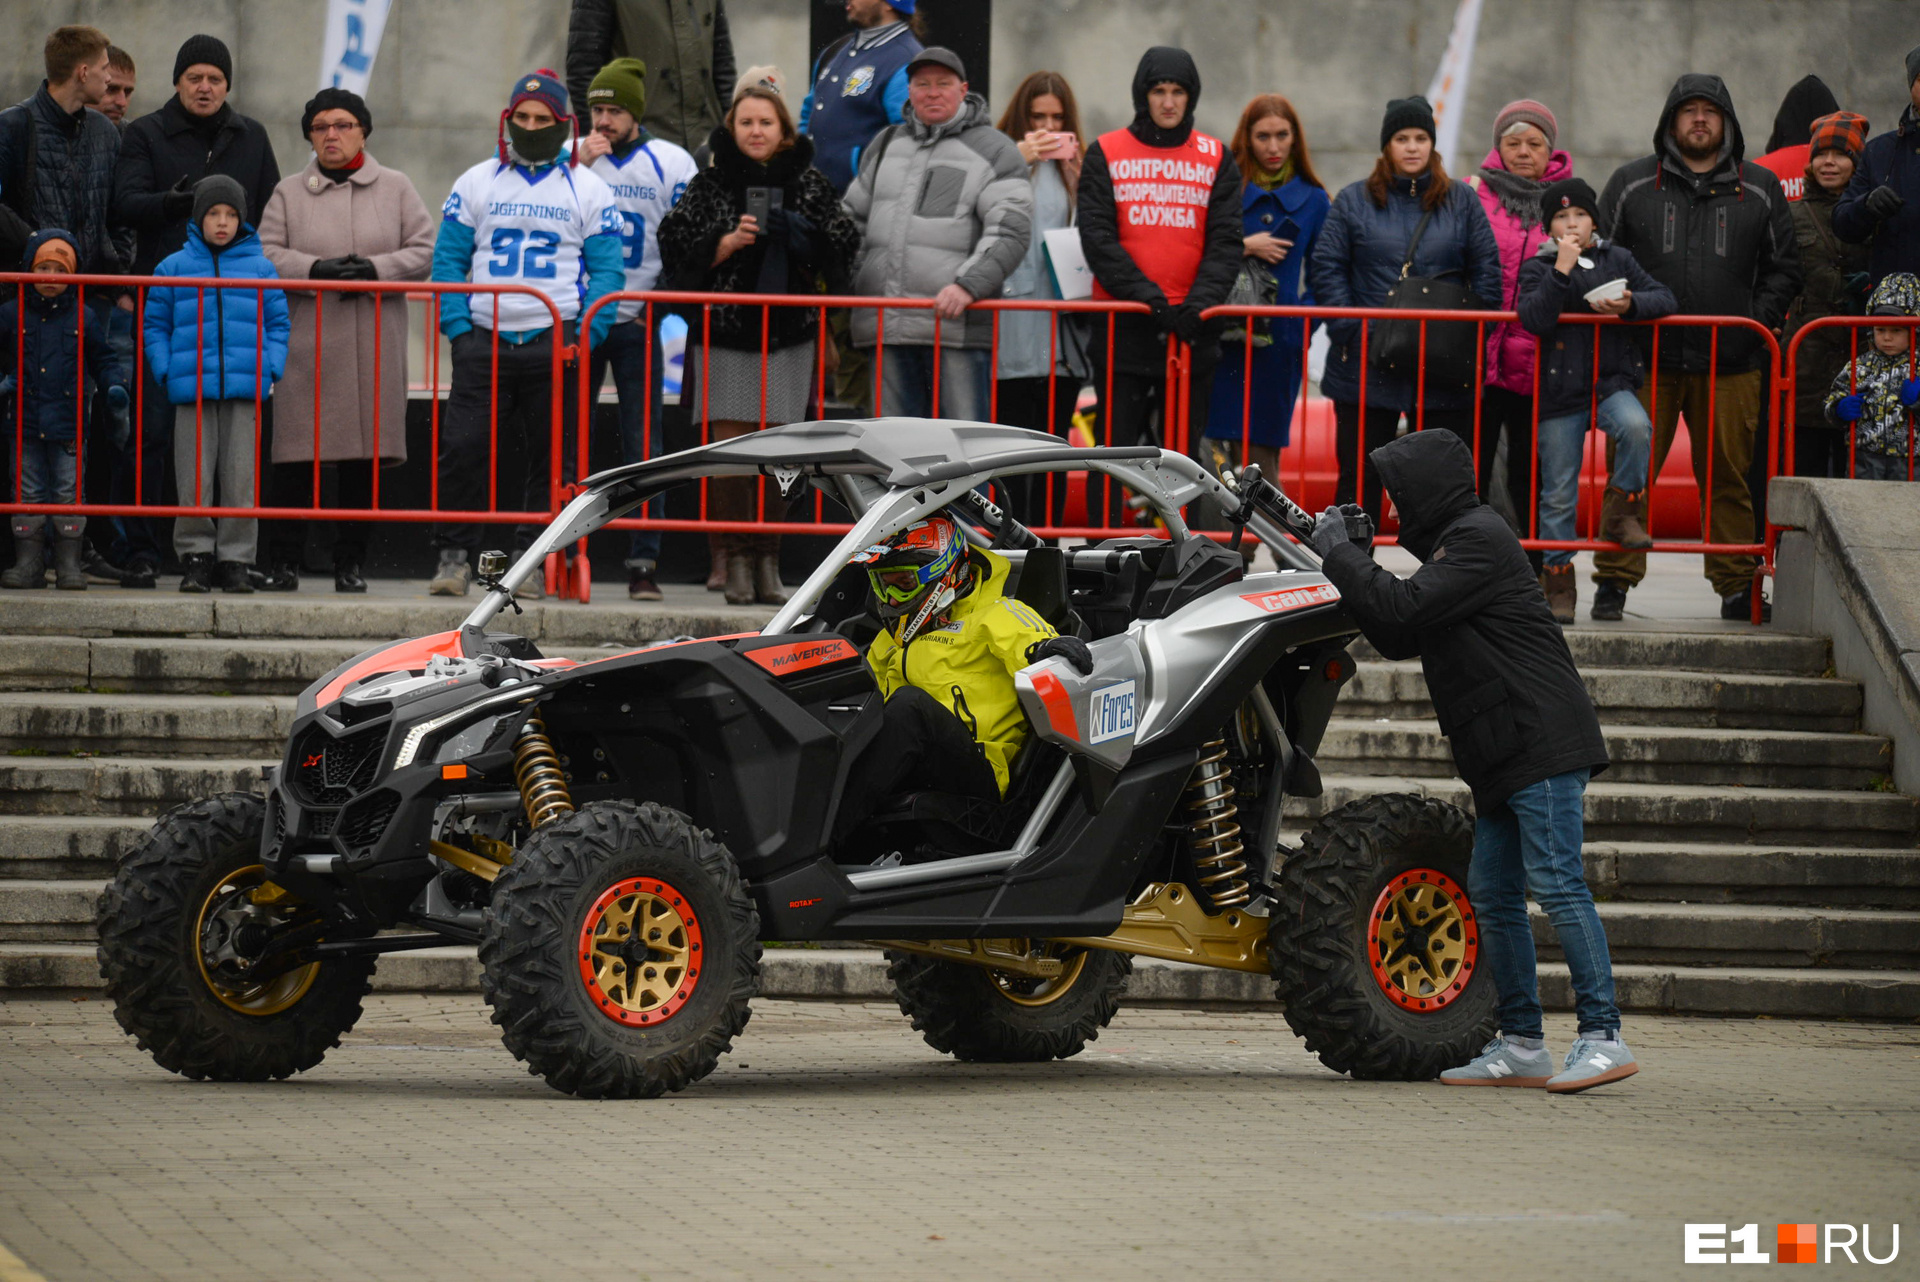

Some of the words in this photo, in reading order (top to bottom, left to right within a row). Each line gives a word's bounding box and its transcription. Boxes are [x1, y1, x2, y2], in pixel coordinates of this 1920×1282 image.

[1196, 136, 1218, 157] 51
[489, 202, 571, 222] LIGHTNINGS
[1128, 205, 1197, 229] СЛУЖБА
[488, 228, 561, 279] 92
[772, 642, 842, 668] MAVERICK
[789, 899, 813, 909] ROTAX
[1486, 1059, 1513, 1079] N
[1589, 1052, 1613, 1070] N
